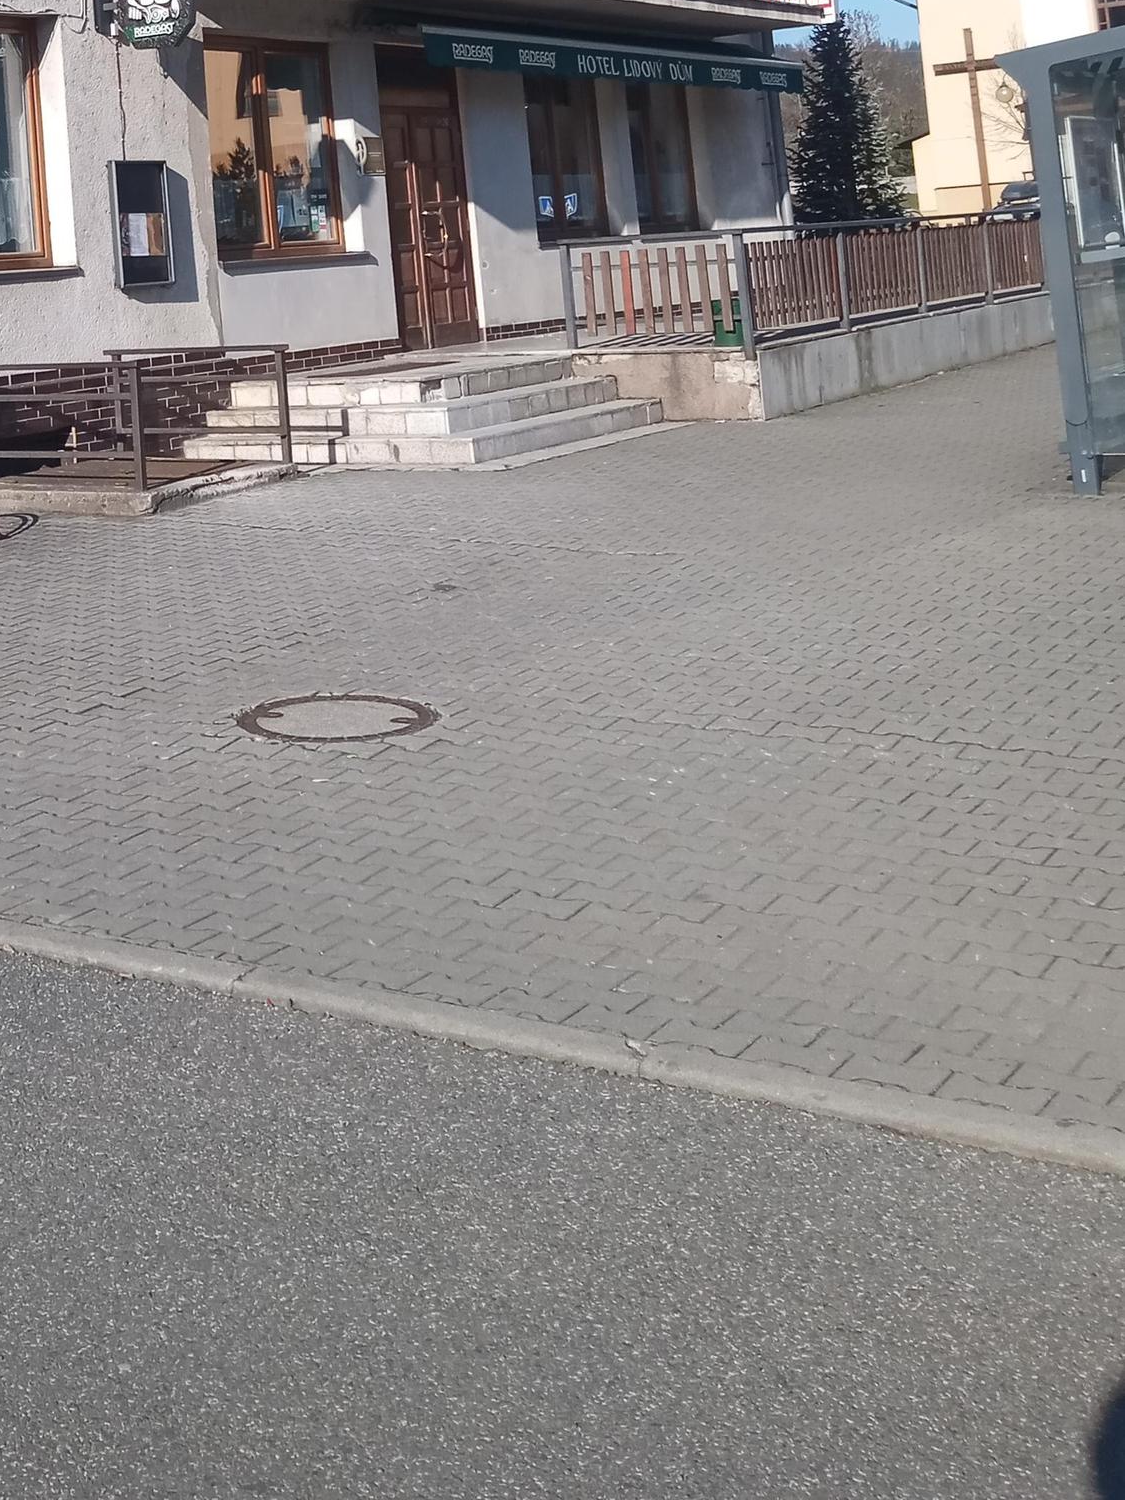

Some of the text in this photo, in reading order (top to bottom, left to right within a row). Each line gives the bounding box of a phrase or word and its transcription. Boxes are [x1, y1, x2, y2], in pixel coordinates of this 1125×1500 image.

[577, 54, 693, 81] HOTEL LIDOVÝ DŮM
